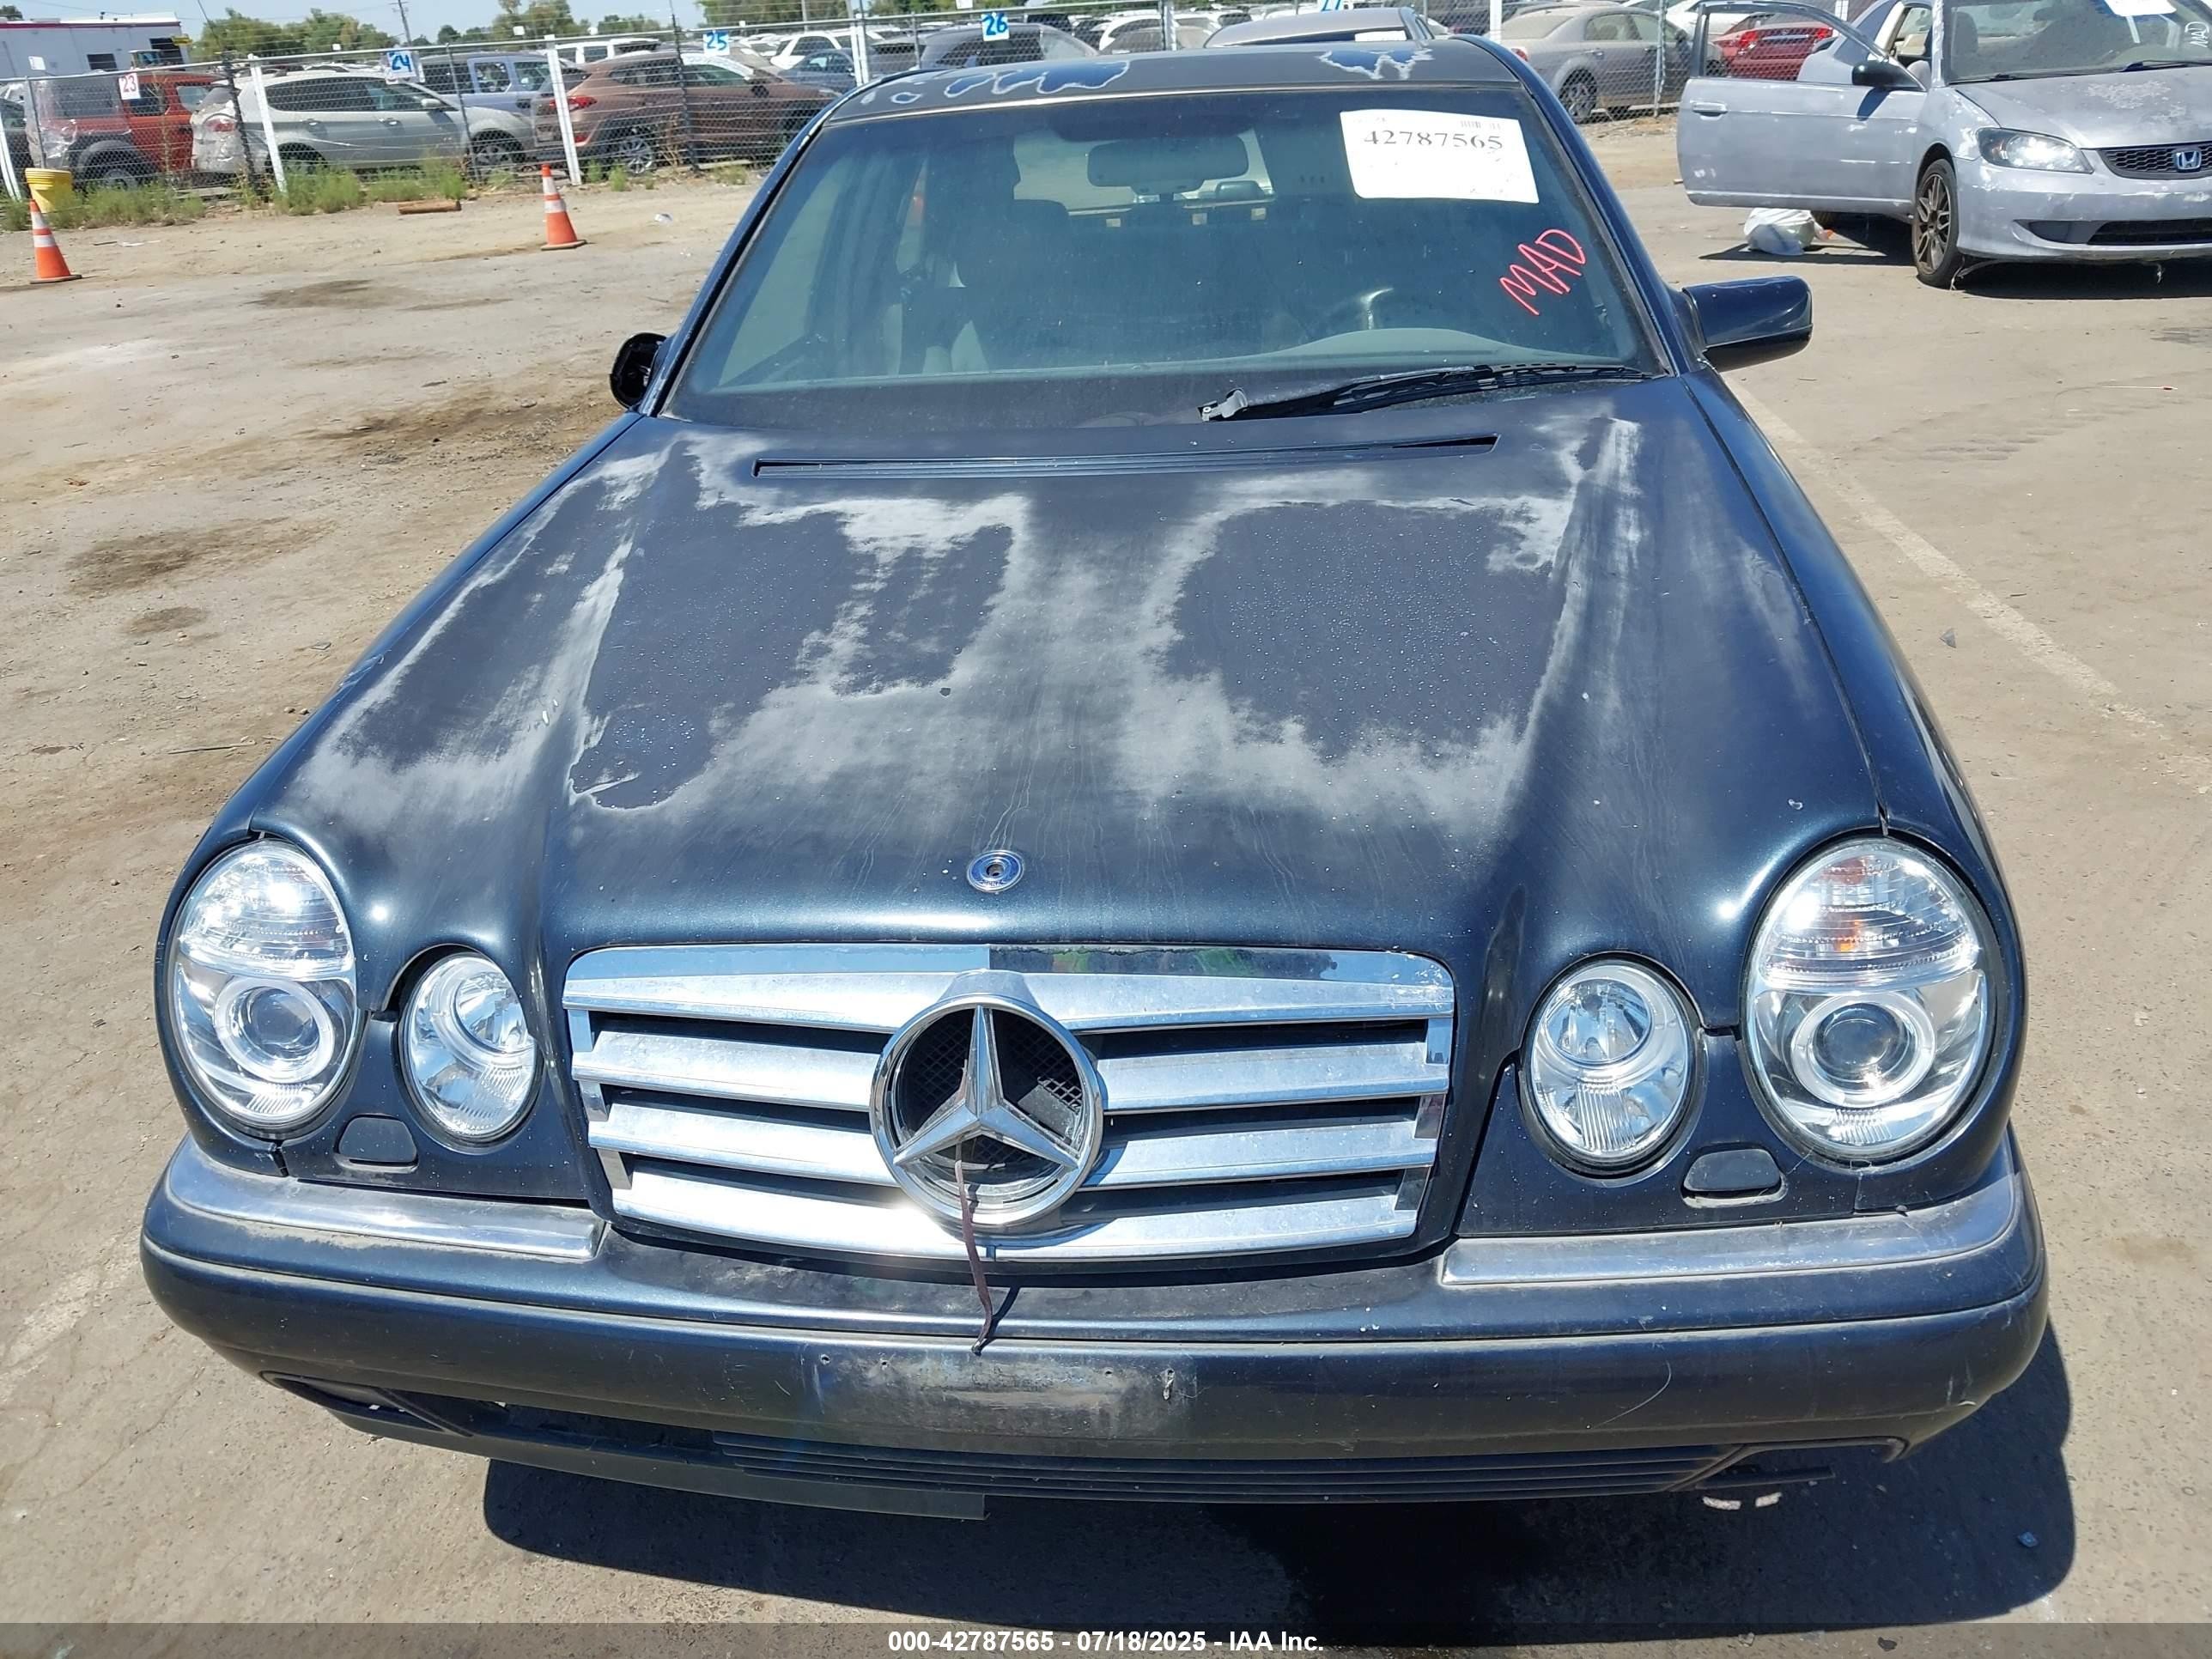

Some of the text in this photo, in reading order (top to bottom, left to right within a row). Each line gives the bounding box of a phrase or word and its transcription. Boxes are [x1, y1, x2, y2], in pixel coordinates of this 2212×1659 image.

[981, 12, 1008, 36] 26
[706, 31, 727, 51] 25
[389, 52, 412, 72] 24
[121, 75, 137, 93] 23
[1364, 129, 1504, 150] 42787565
[1499, 228, 1586, 316] MAD
